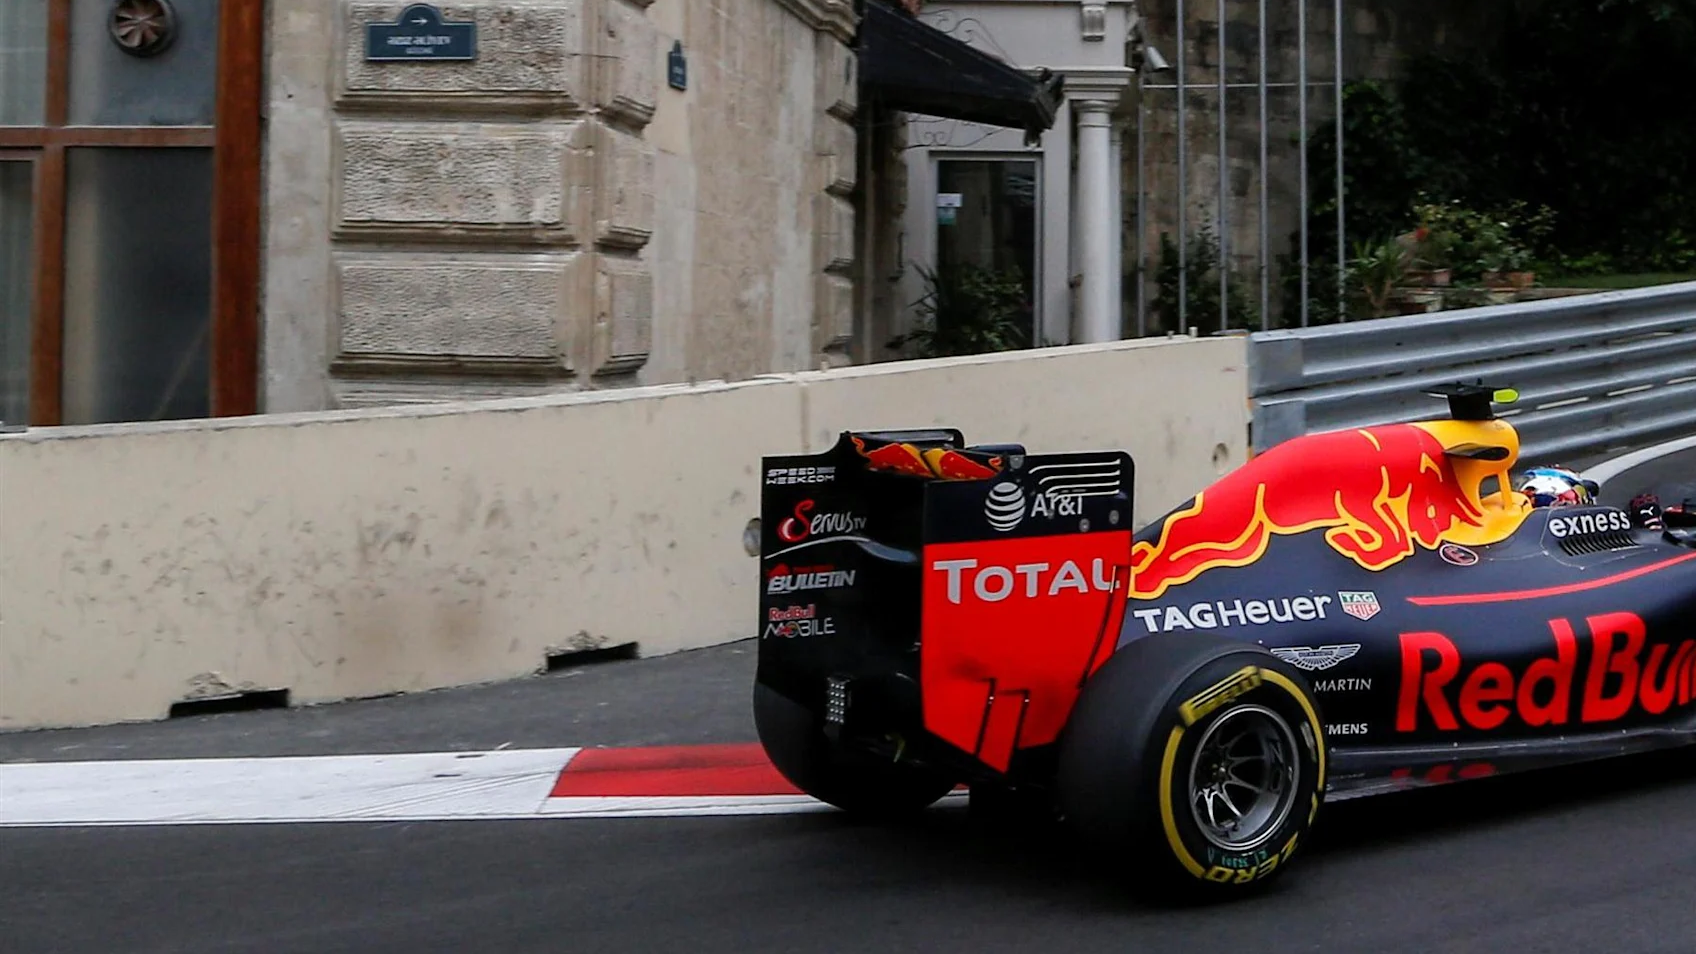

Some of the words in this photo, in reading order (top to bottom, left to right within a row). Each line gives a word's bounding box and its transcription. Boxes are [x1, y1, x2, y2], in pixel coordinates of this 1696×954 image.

[1548, 511, 1631, 538] exness
[933, 557, 1121, 605] TOTAL
[1343, 595, 1375, 603] TAG
[1314, 678, 1372, 693] MARTIN
[1325, 723, 1369, 736] MENS
